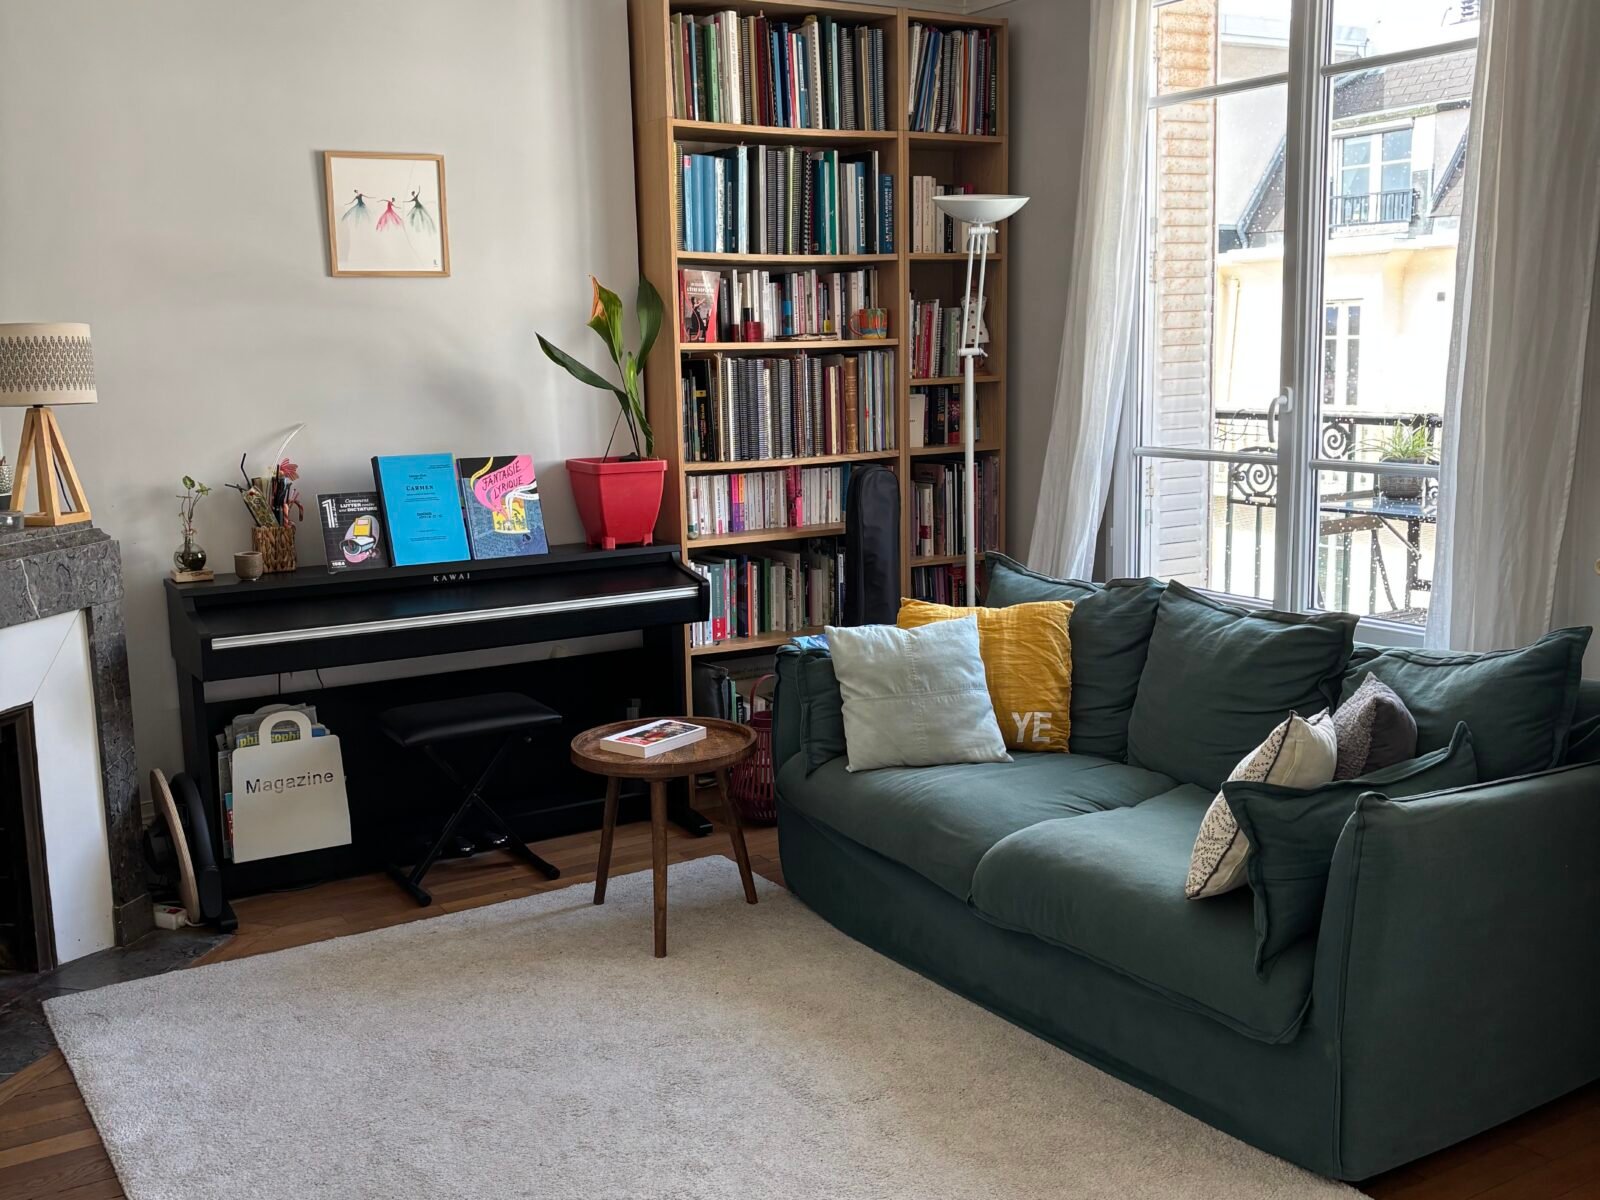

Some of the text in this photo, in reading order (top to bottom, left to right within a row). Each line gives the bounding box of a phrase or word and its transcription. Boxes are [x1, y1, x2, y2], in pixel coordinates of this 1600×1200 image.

[482, 460, 521, 491] FANTAISIE
[494, 476, 523, 499] LYRIQUE
[321, 498, 336, 529] 1
[433, 572, 470, 582] KAWAI
[1011, 711, 1052, 743] YE
[246, 771, 334, 795] Magazine
